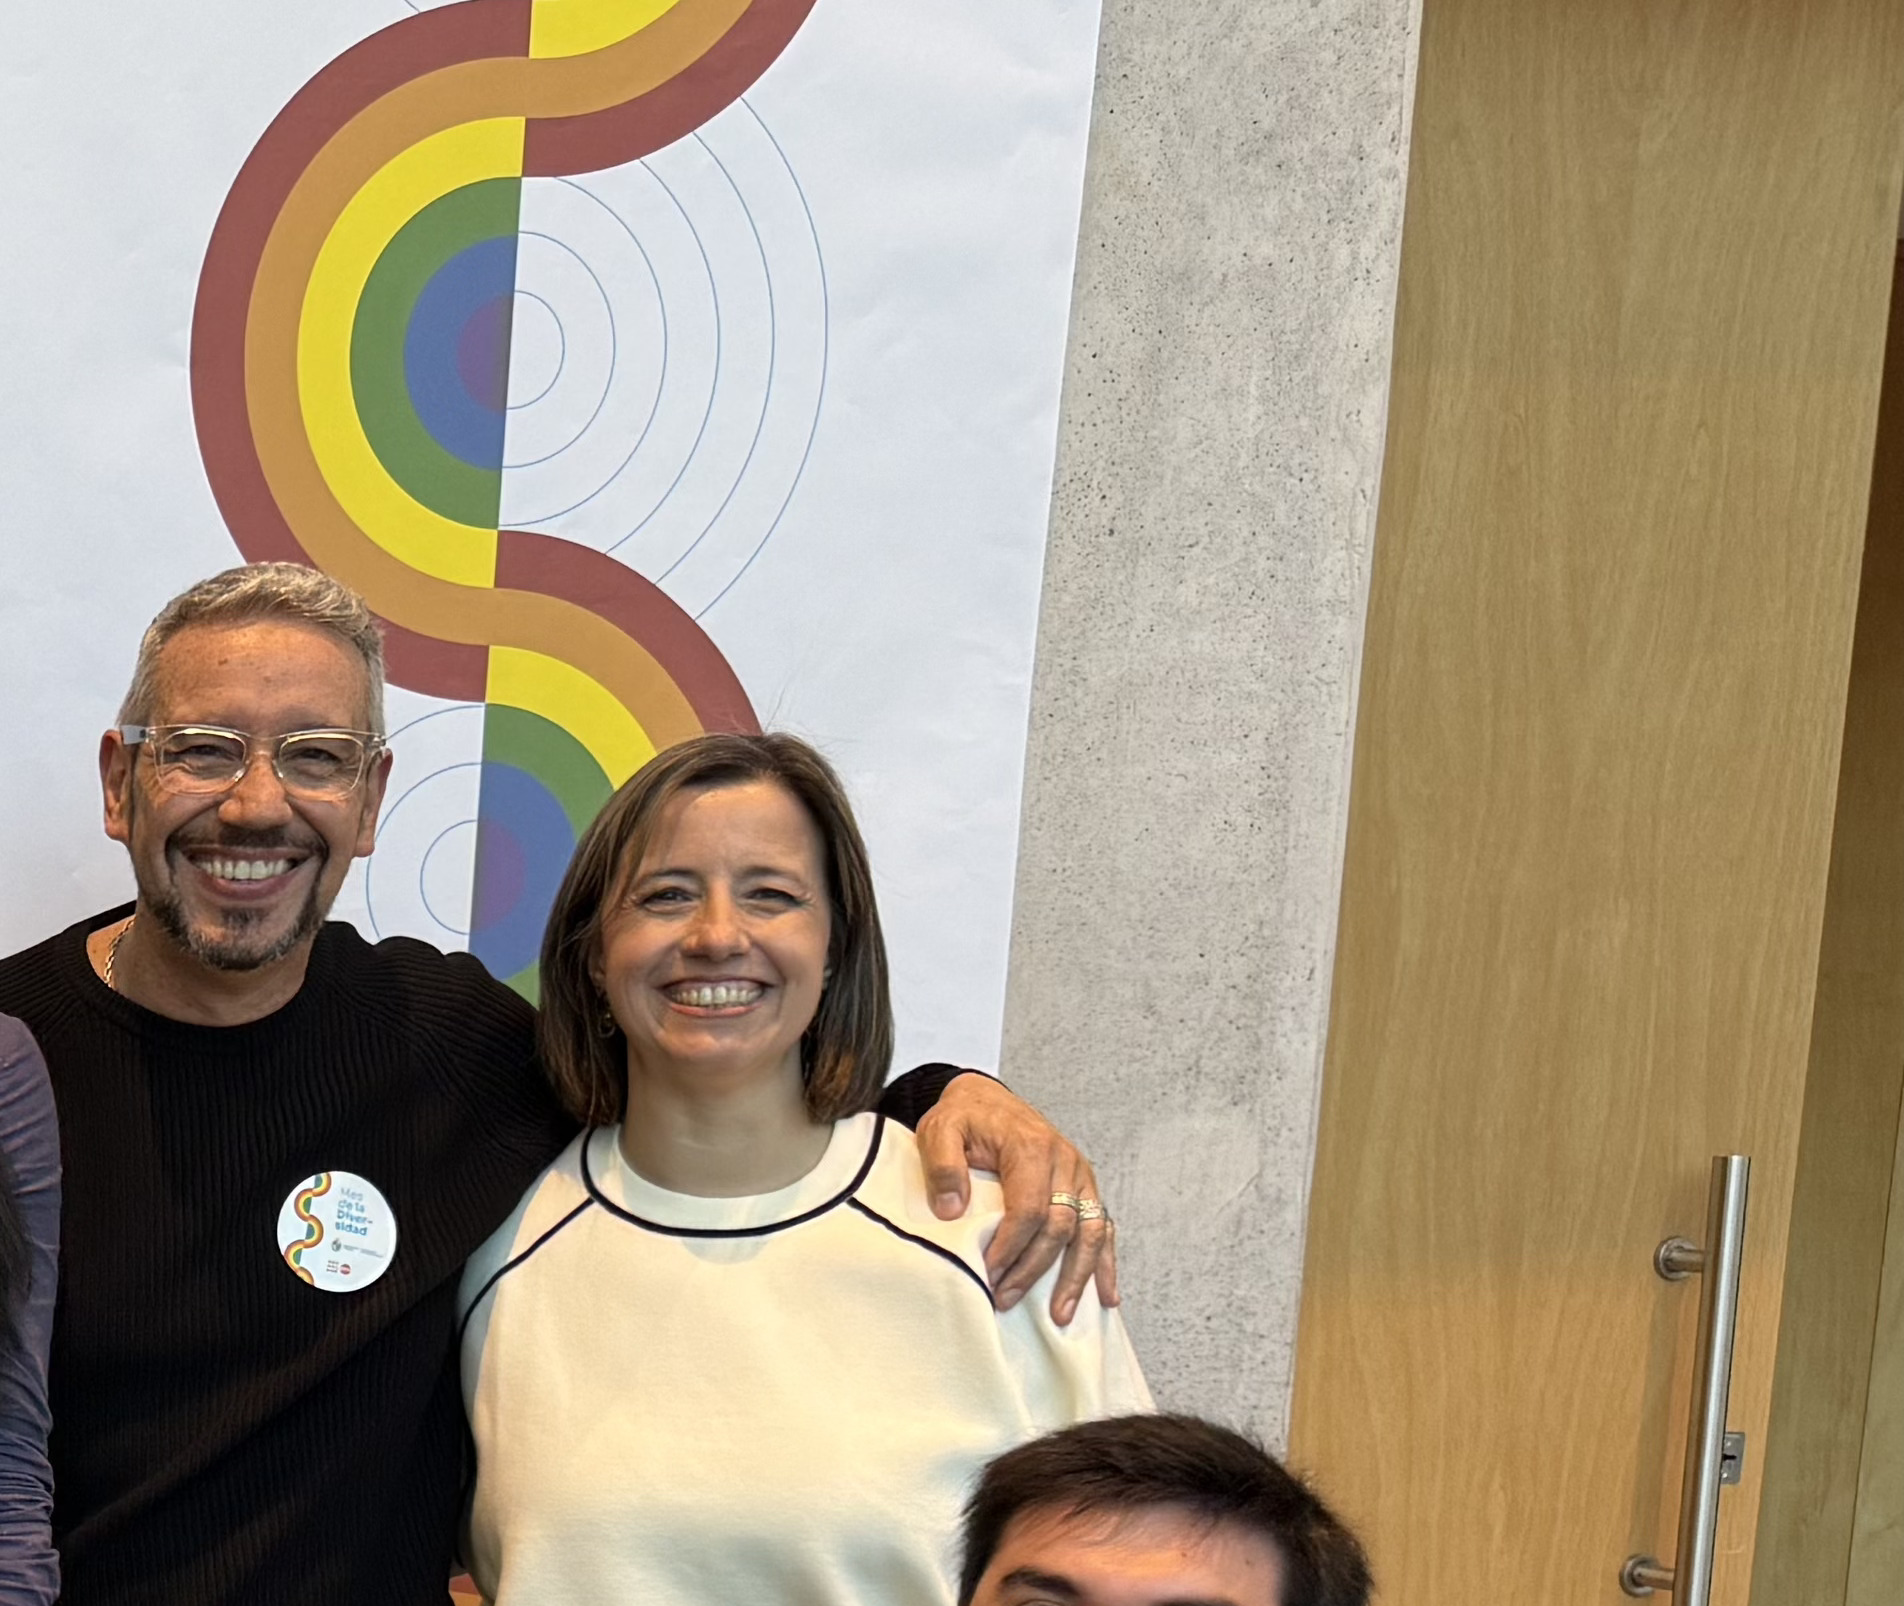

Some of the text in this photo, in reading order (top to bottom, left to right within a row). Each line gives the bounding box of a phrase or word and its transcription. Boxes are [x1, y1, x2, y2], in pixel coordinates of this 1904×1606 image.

[338, 1199, 366, 1213] de la
[337, 1210, 373, 1225] Diver-
[335, 1222, 368, 1236] sidad
